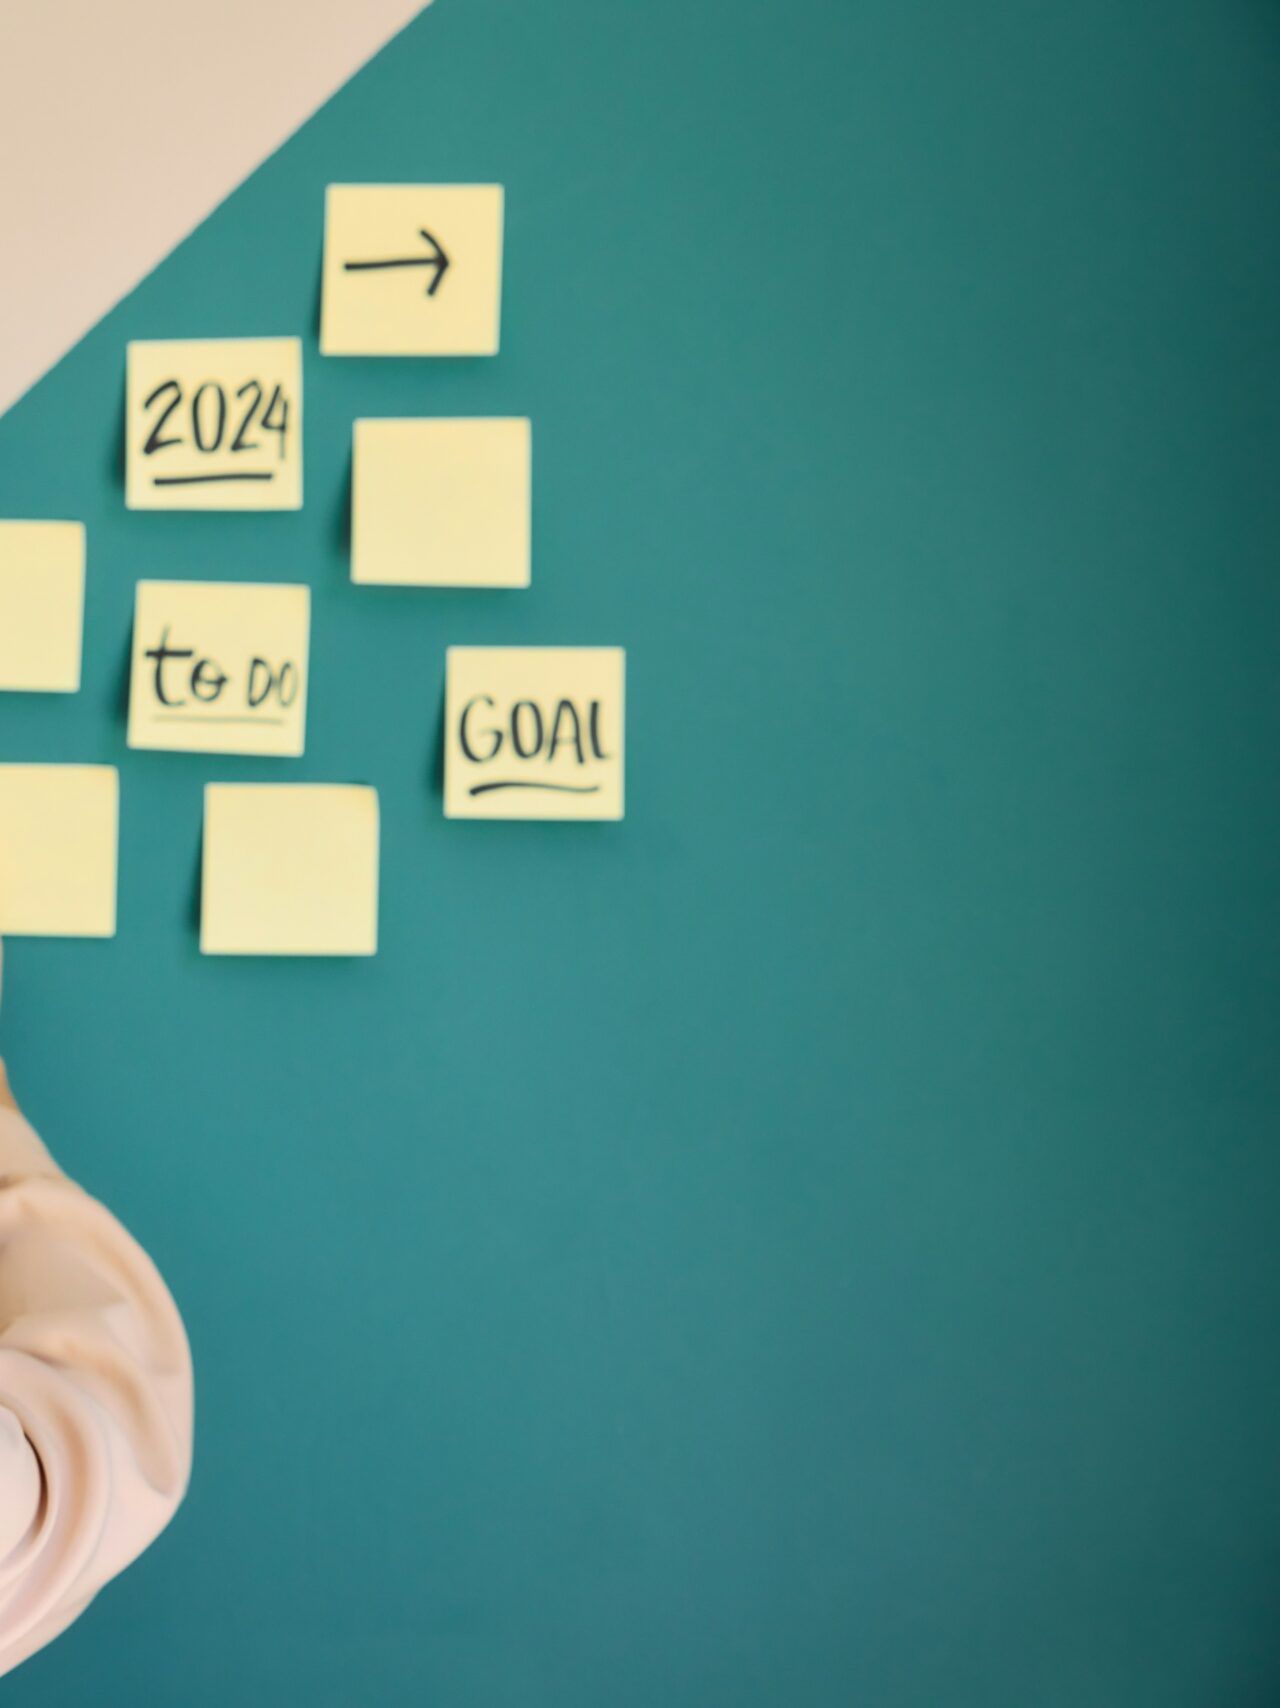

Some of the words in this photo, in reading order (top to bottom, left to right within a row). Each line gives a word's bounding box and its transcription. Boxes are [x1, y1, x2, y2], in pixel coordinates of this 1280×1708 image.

[143, 380, 289, 460] 2024
[144, 625, 228, 708] to
[247, 657, 298, 709] DO
[459, 694, 610, 765] GOAL
